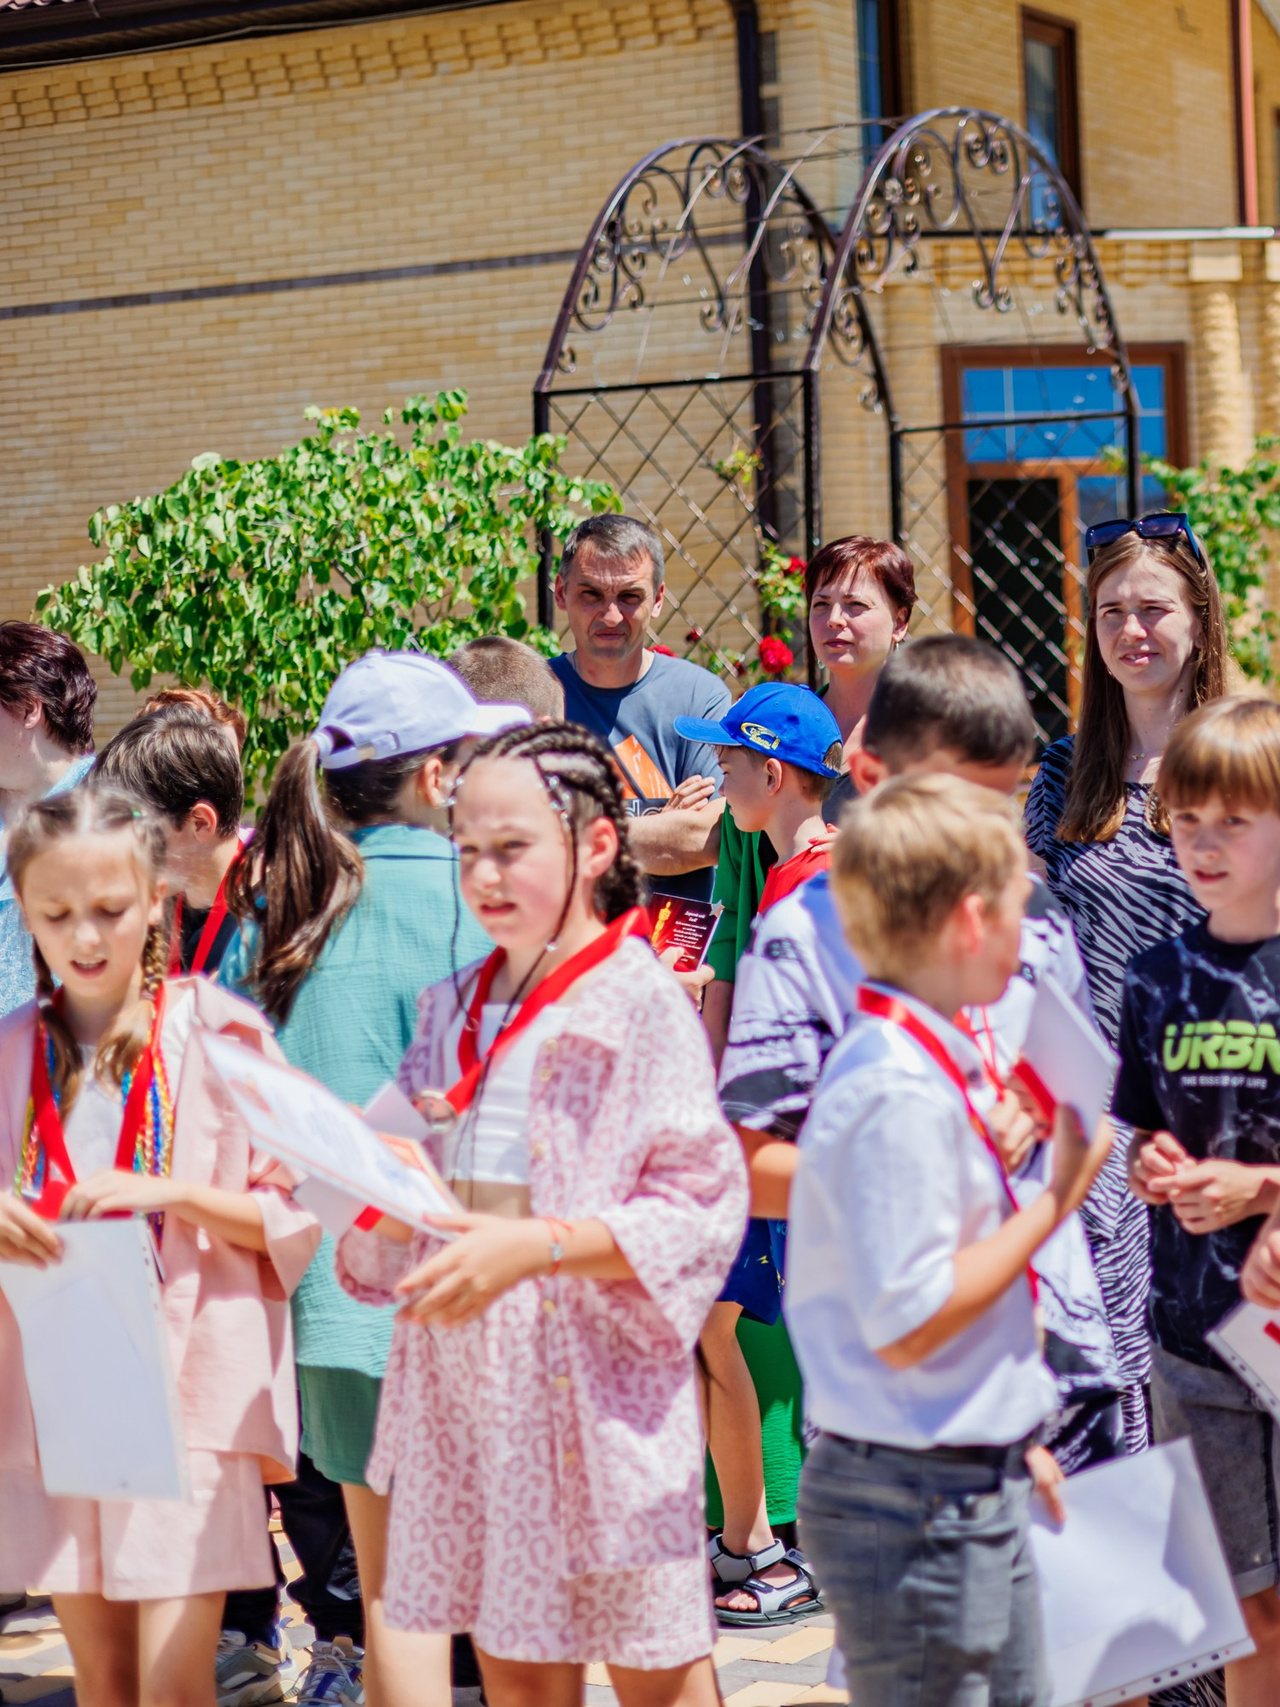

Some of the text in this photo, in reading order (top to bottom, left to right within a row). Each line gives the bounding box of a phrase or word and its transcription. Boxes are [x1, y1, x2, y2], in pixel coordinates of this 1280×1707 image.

[1181, 1075, 1197, 1087] THE
[1231, 1075, 1245, 1087] OF
[1247, 1077, 1268, 1090] LIFE
